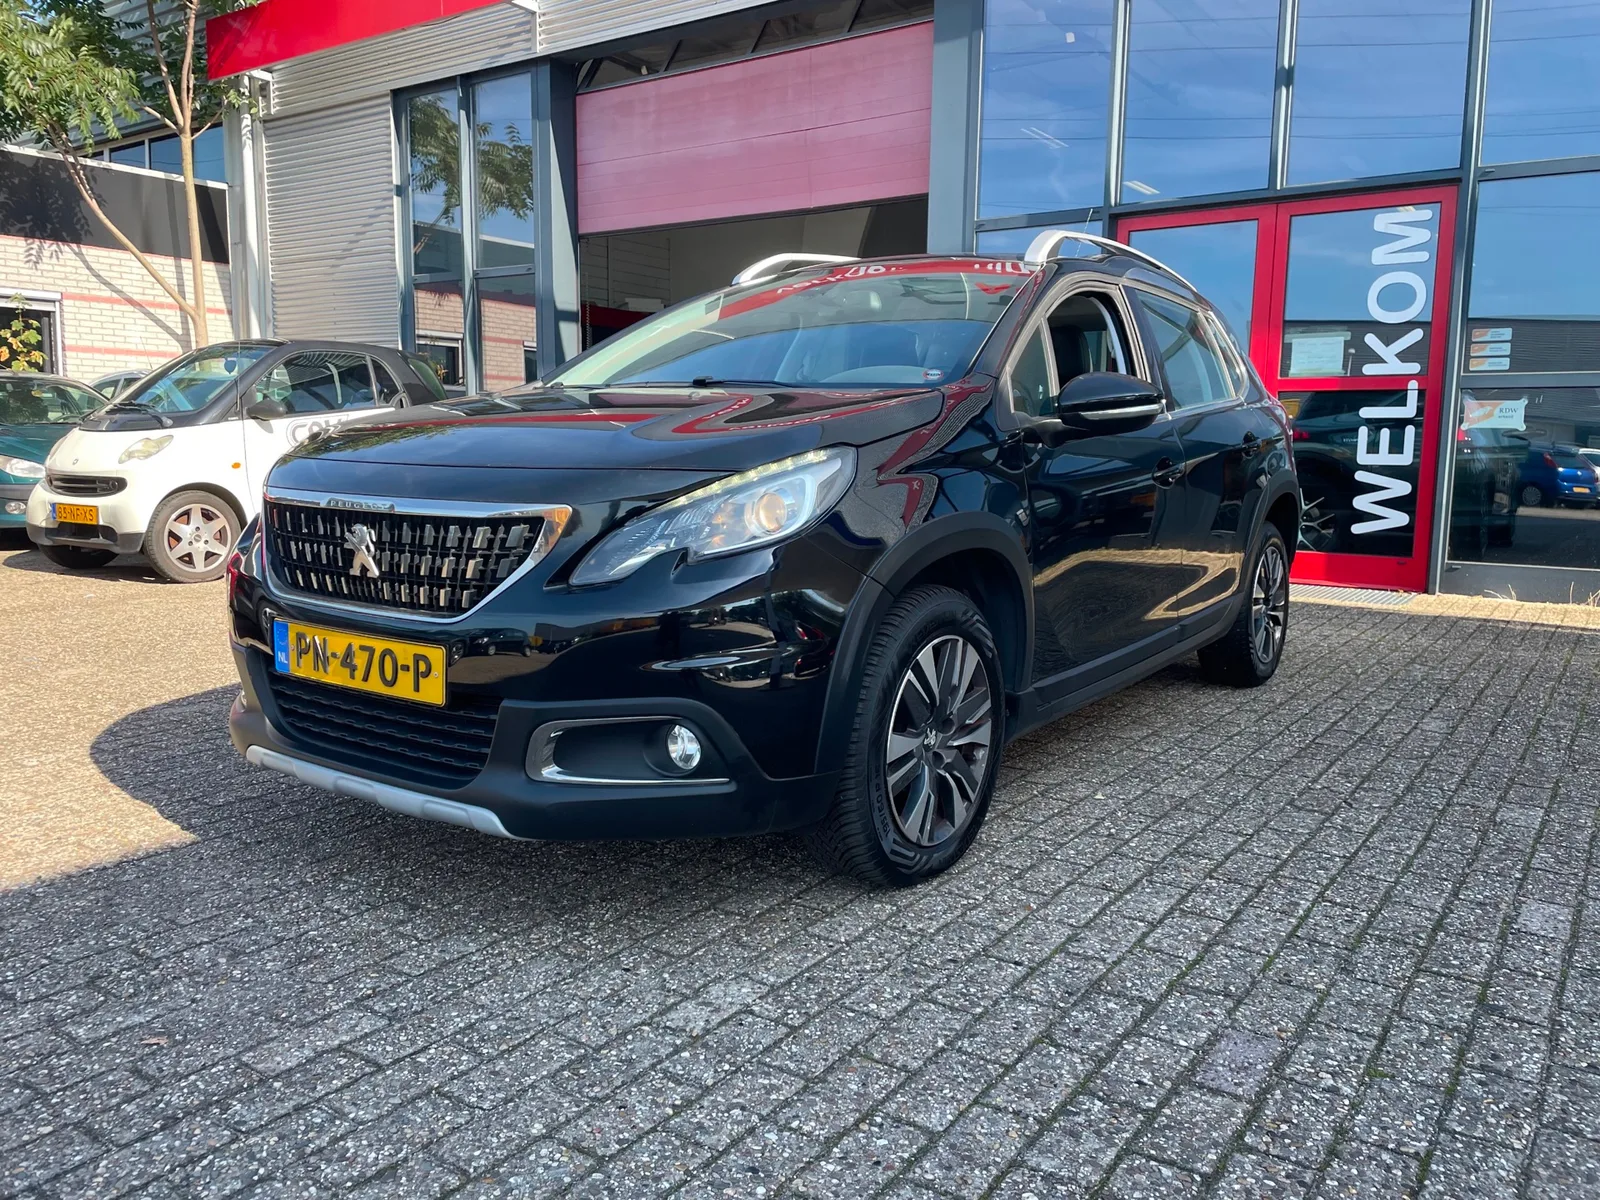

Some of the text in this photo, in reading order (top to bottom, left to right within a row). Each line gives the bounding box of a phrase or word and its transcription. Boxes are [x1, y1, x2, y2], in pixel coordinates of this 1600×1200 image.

[1350, 209, 1433, 534] WELKOM
[330, 500, 387, 510] PEUGEOT
[57, 506, 94, 521] 85-NF-XS
[277, 650, 288, 664] NL
[295, 631, 432, 693] PN-470-P
